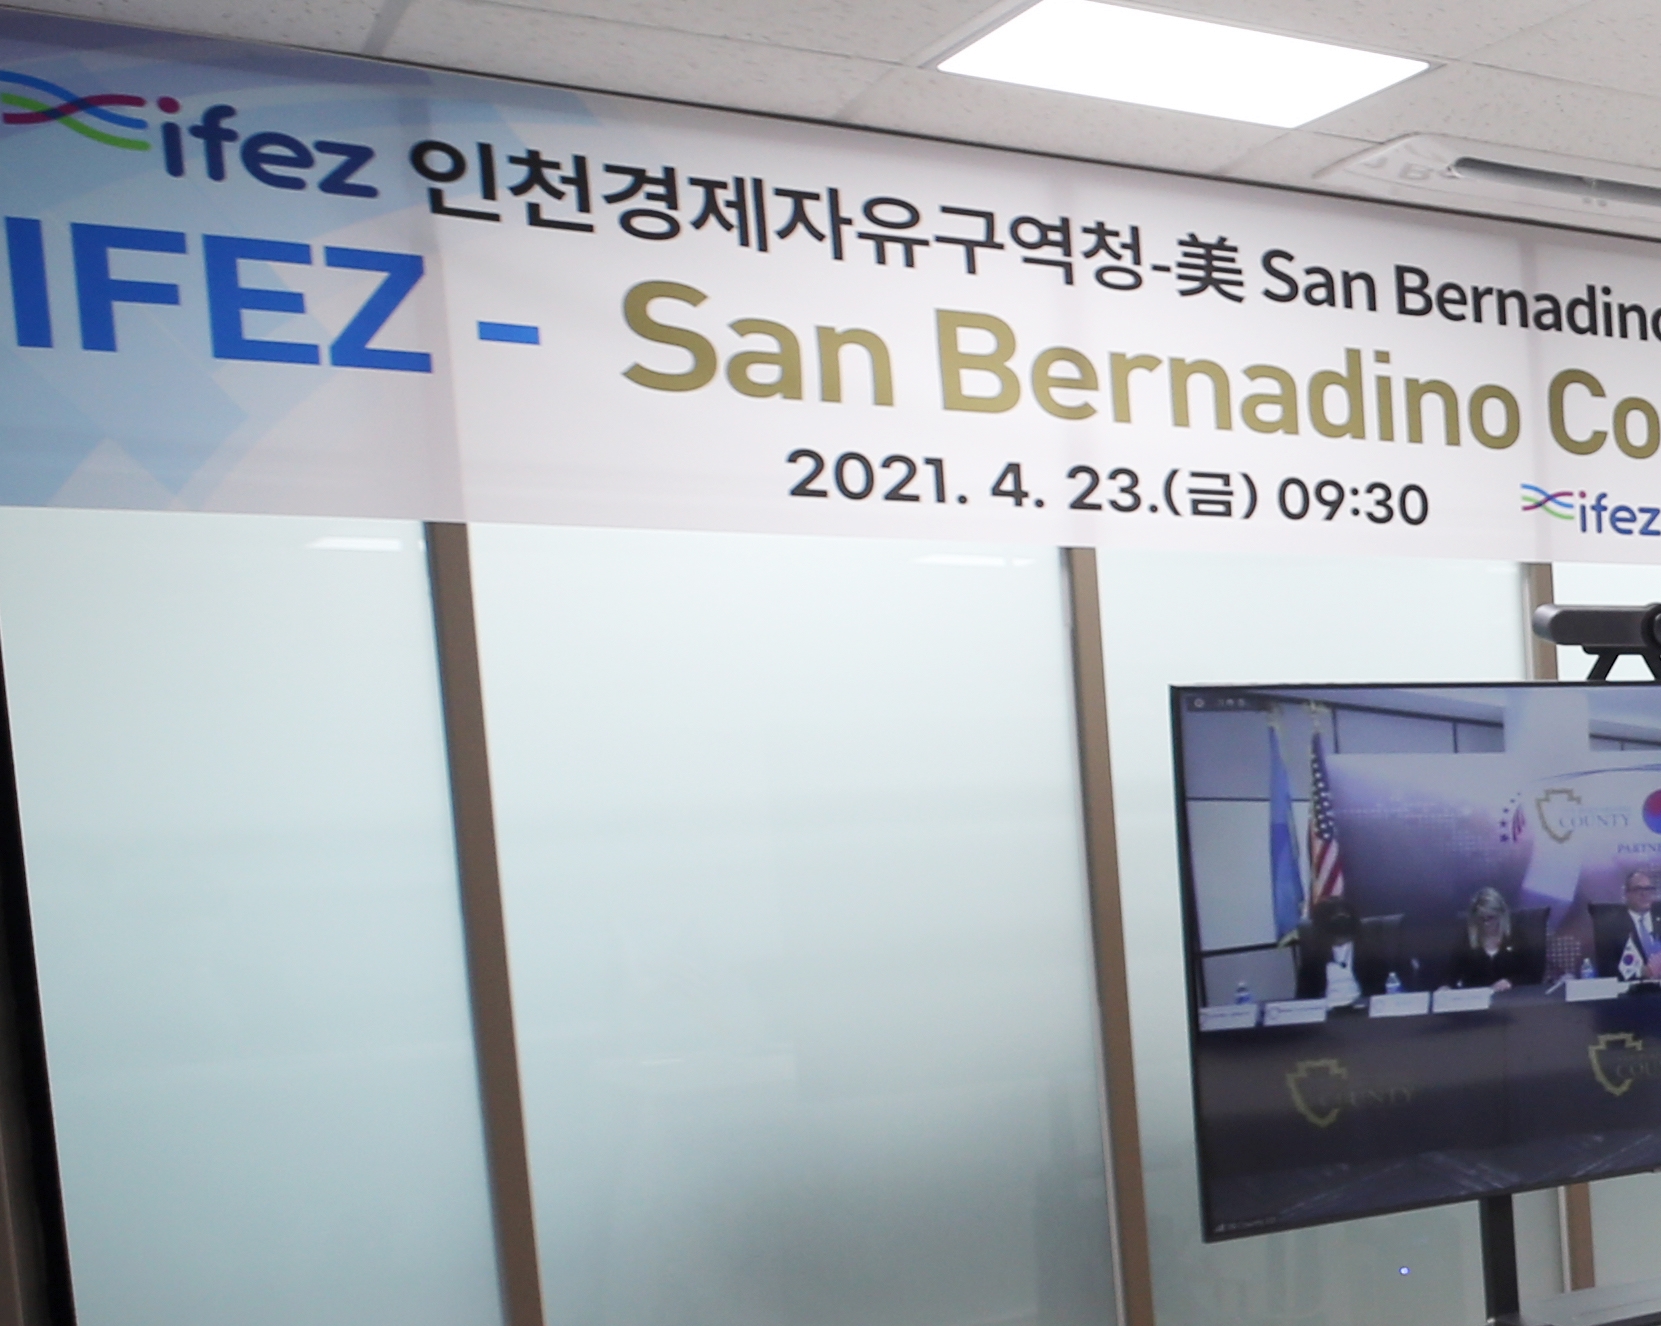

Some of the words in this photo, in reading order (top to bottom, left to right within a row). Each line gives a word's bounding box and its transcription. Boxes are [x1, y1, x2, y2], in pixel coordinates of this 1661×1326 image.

[157, 96, 379, 199] ifez
[1262, 249, 1377, 311] San
[5, 217, 433, 373] IFEZ
[622, 280, 894, 406] San
[934, 308, 1520, 450] Bernadino
[787, 449, 967, 504] 2021.
[991, 463, 1044, 508] 4.
[1067, 465, 1257, 519] 23.(금)
[1278, 478, 1428, 525] 09:30
[1579, 491, 1661, 536] ifez
